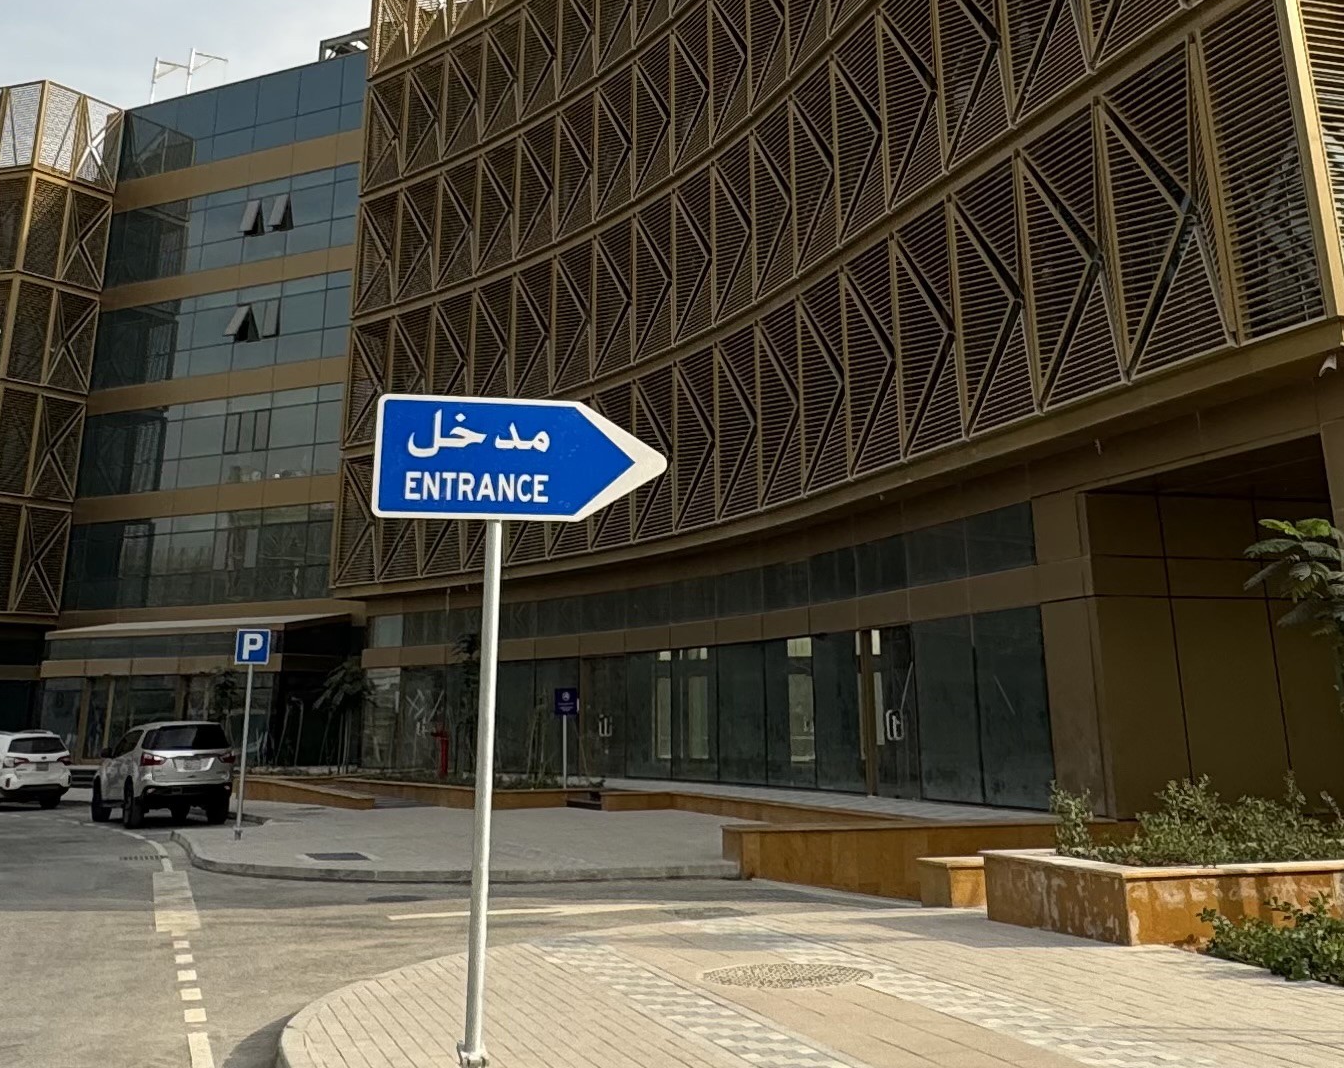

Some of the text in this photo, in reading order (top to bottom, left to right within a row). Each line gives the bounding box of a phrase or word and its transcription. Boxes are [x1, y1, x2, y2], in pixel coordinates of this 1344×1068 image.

[407, 409, 551, 458] مدخل
[404, 470, 550, 504] ENTRANCE
[242, 633, 264, 660] P
